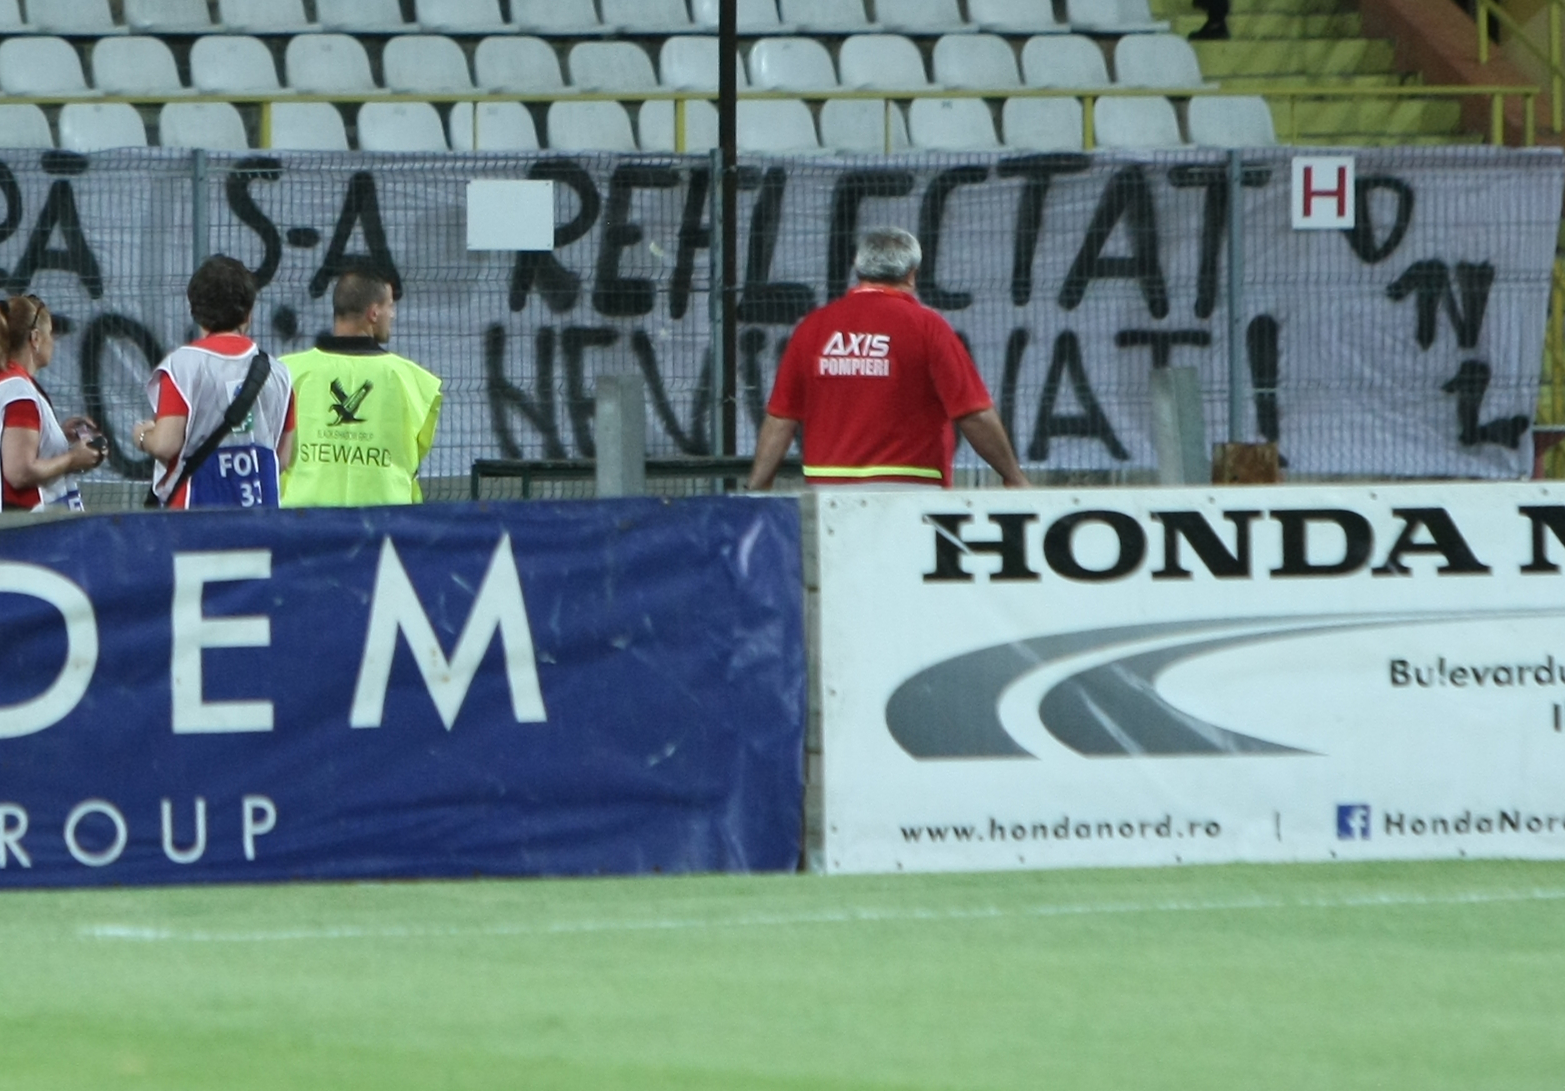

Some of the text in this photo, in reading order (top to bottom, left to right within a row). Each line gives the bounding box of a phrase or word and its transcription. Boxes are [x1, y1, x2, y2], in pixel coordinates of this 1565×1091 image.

[1302, 165, 1347, 217] H
[822, 331, 891, 357] AXIS
[818, 357, 891, 377] POMPIERI
[299, 442, 392, 468] STEWARD
[921, 506, 1494, 583] HONDA
[901, 812, 1223, 843] www.hondanord.ro
